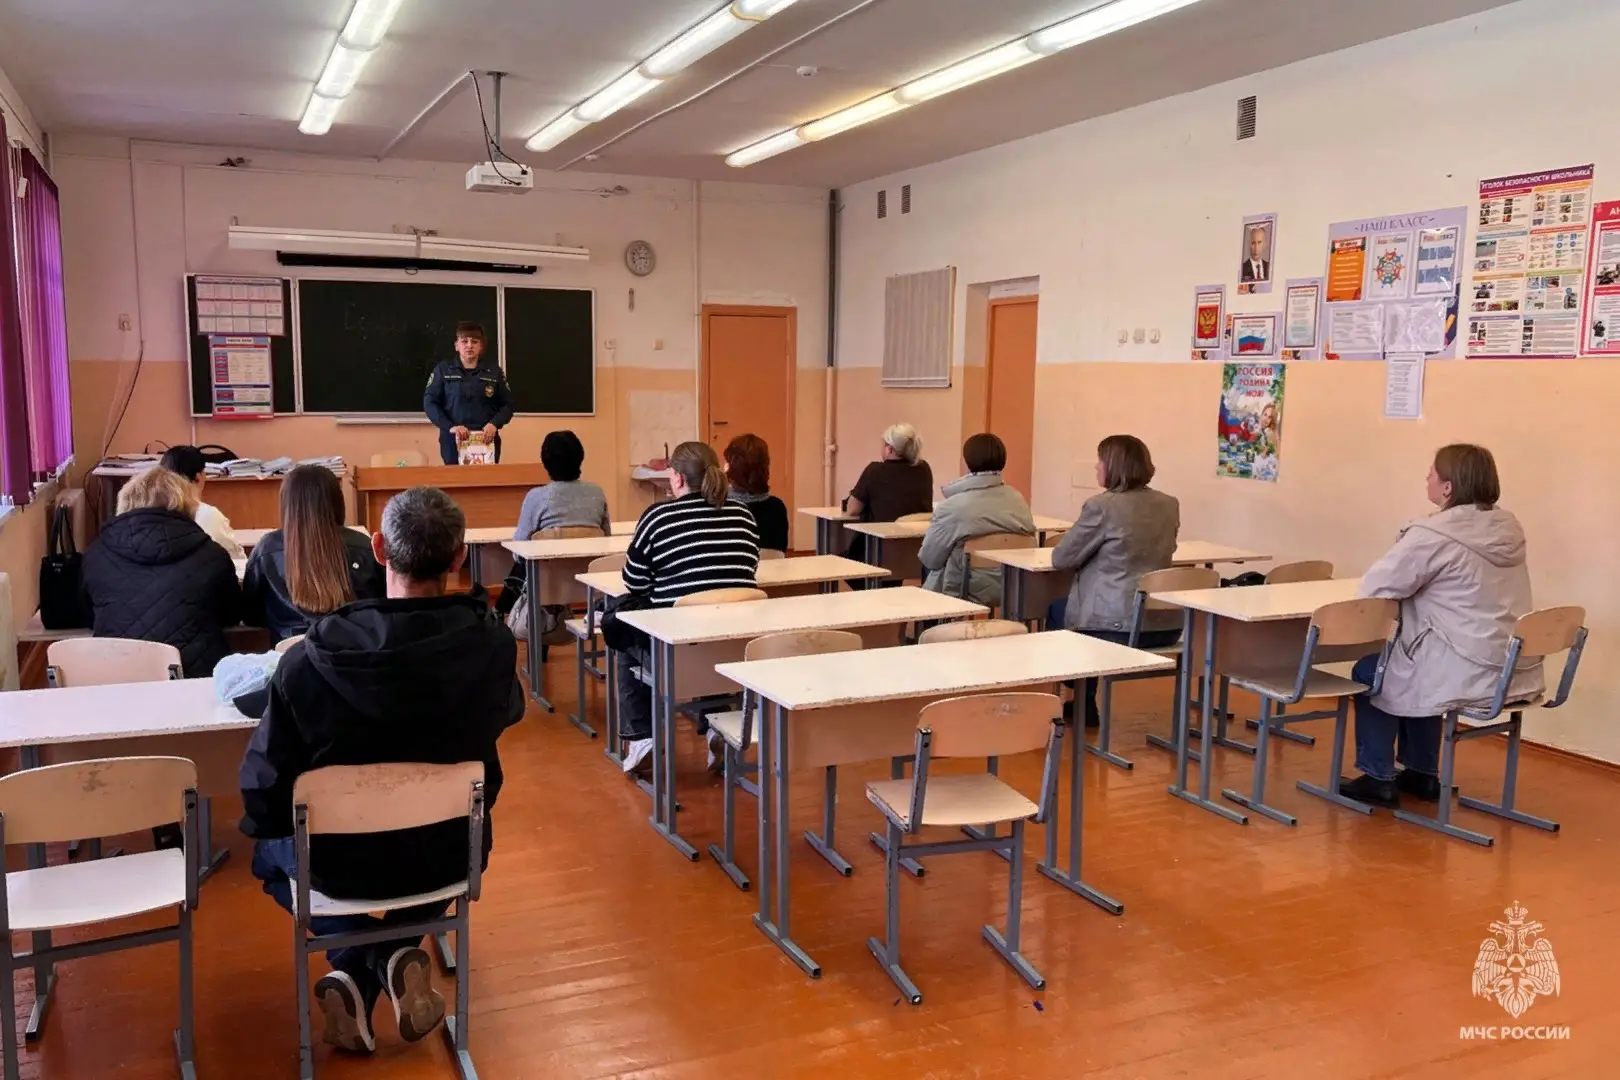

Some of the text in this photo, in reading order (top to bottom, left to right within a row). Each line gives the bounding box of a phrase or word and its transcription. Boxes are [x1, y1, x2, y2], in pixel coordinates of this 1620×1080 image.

[1505, 174, 1550, 187] БЕЗОПАСНОСТИ
[1551, 169, 1590, 180] ШКОЛЬНИКА
[1237, 367, 1273, 376] РОССИЯ
